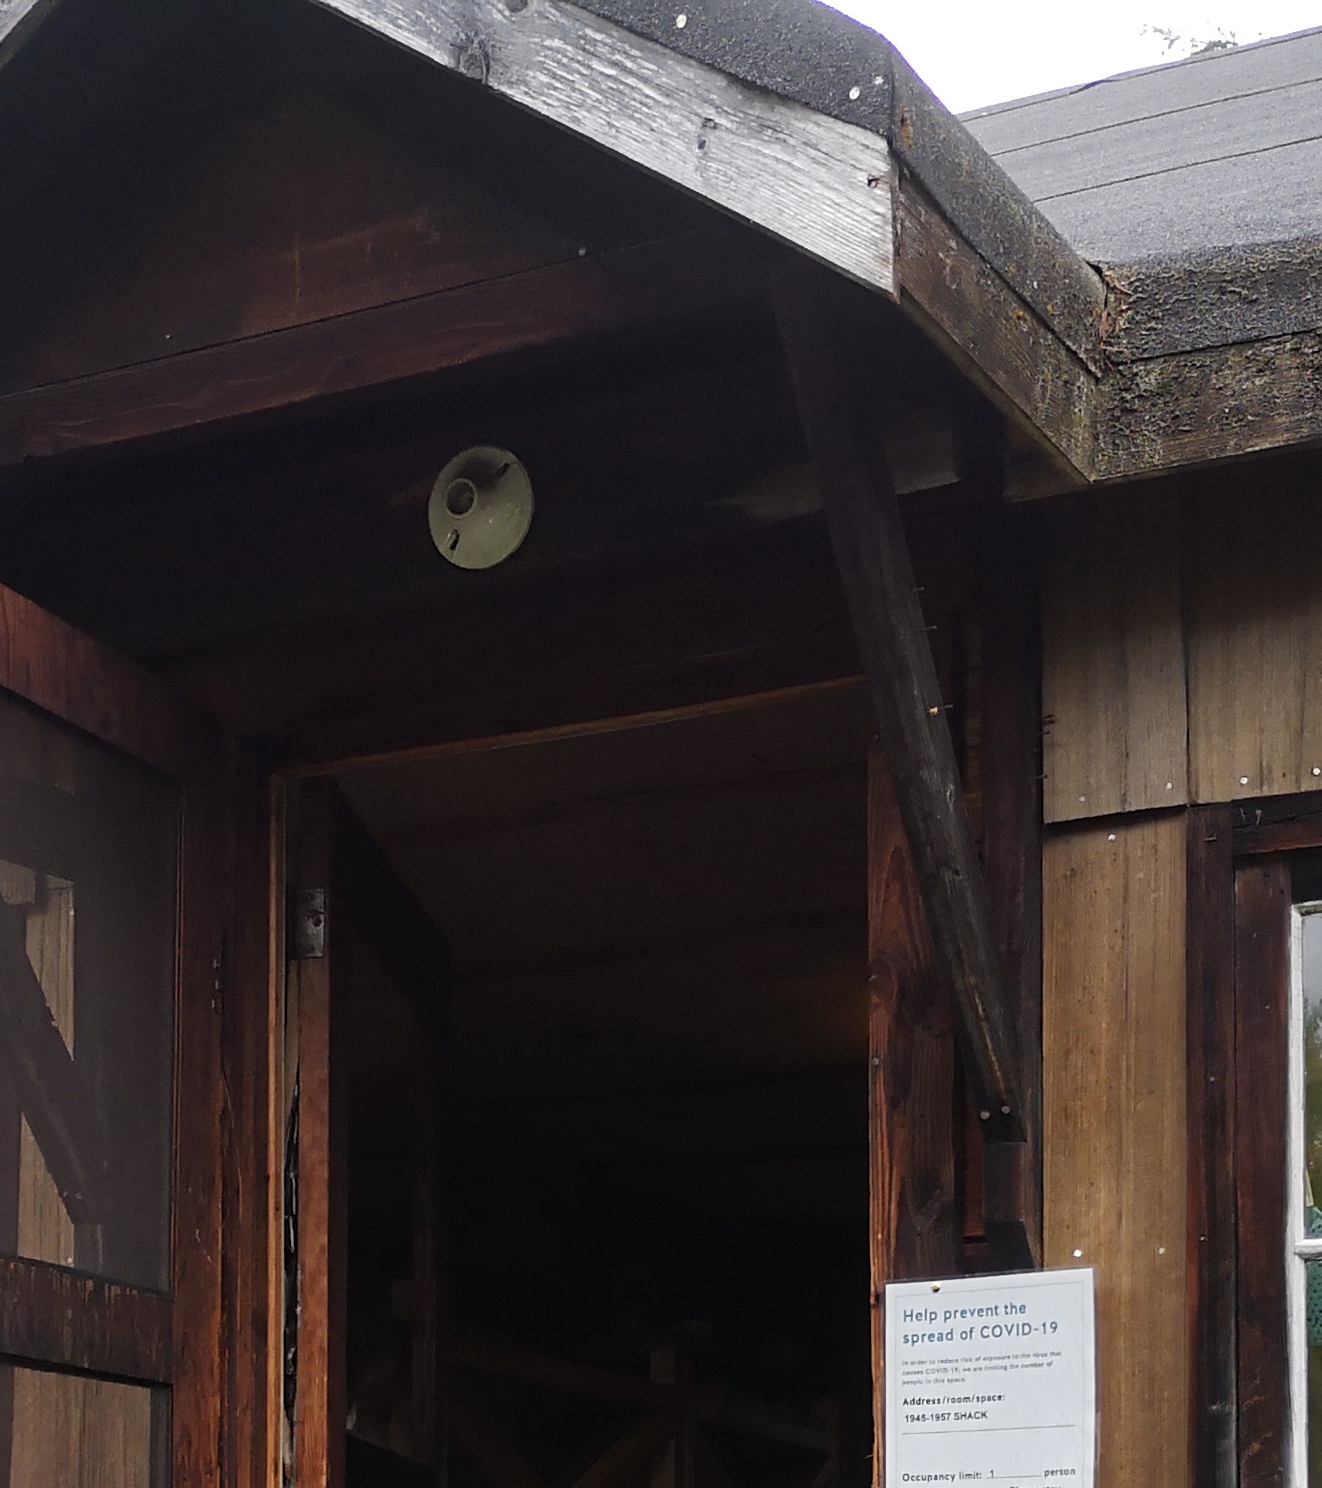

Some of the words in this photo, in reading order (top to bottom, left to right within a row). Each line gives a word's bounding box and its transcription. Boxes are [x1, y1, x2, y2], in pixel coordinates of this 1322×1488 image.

[903, 1308, 937, 1323] Help
[943, 1304, 999, 1322] prevent
[1003, 1301, 1026, 1315] the
[902, 1328, 953, 1345] spread
[959, 1326, 975, 1340] of
[979, 1321, 1057, 1338] COVID-19
[904, 1412, 951, 1423] 1945-1957
[953, 1410, 987, 1420] SHACK
[901, 1472, 955, 1482] Occupancy
[958, 1470, 982, 1480] limit:
[1043, 1468, 1075, 1478] person
